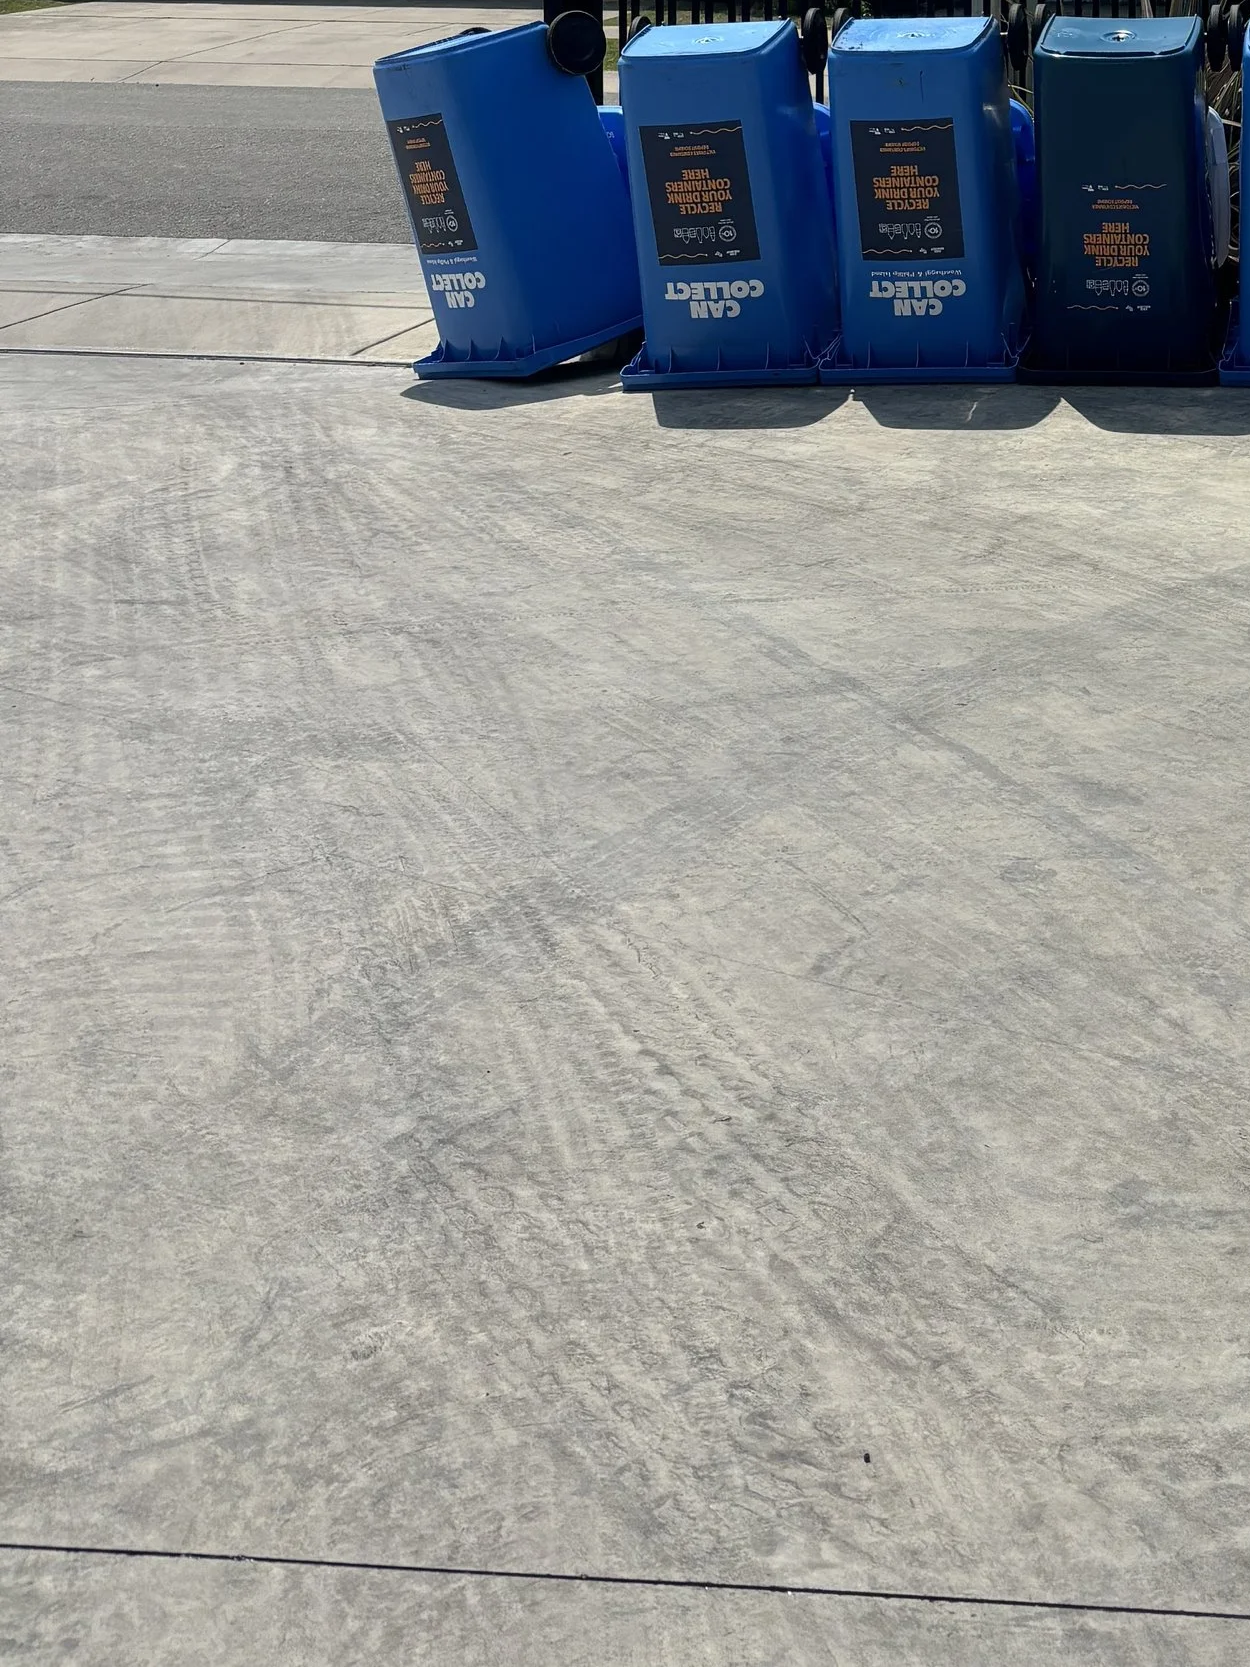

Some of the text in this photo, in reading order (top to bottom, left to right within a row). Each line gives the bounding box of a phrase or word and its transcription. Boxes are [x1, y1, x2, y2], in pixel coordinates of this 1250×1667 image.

[415, 160, 431, 172] HERE
[890, 165, 918, 175] HERE
[409, 170, 445, 183] CONTAINERS
[682, 168, 709, 180] HERE
[412, 181, 448, 194] YOUR DRINK
[666, 178, 731, 191] CONTAINERS
[873, 176, 939, 187] CONTAINERS
[420, 193, 445, 204] RECYCLE
[667, 190, 732, 203] YOUR DRINK
[875, 188, 939, 199] YOUR DRINK
[680, 202, 722, 214] RECYCLE
[886, 199, 929, 210] RECYCLE
[1102, 222, 1129, 232] HERE
[1084, 234, 1149, 244] CONTAINERS
[1084, 245, 1149, 256] YOUR DRINK
[1096, 256, 1138, 266] RECYCLE
[430, 272, 485, 291] COLLECT
[665, 280, 764, 300] COLLECT
[870, 279, 966, 298] COLLECT
[445, 291, 475, 308] CAN
[690, 300, 740, 318] CAN
[894, 298, 943, 316] CAN
